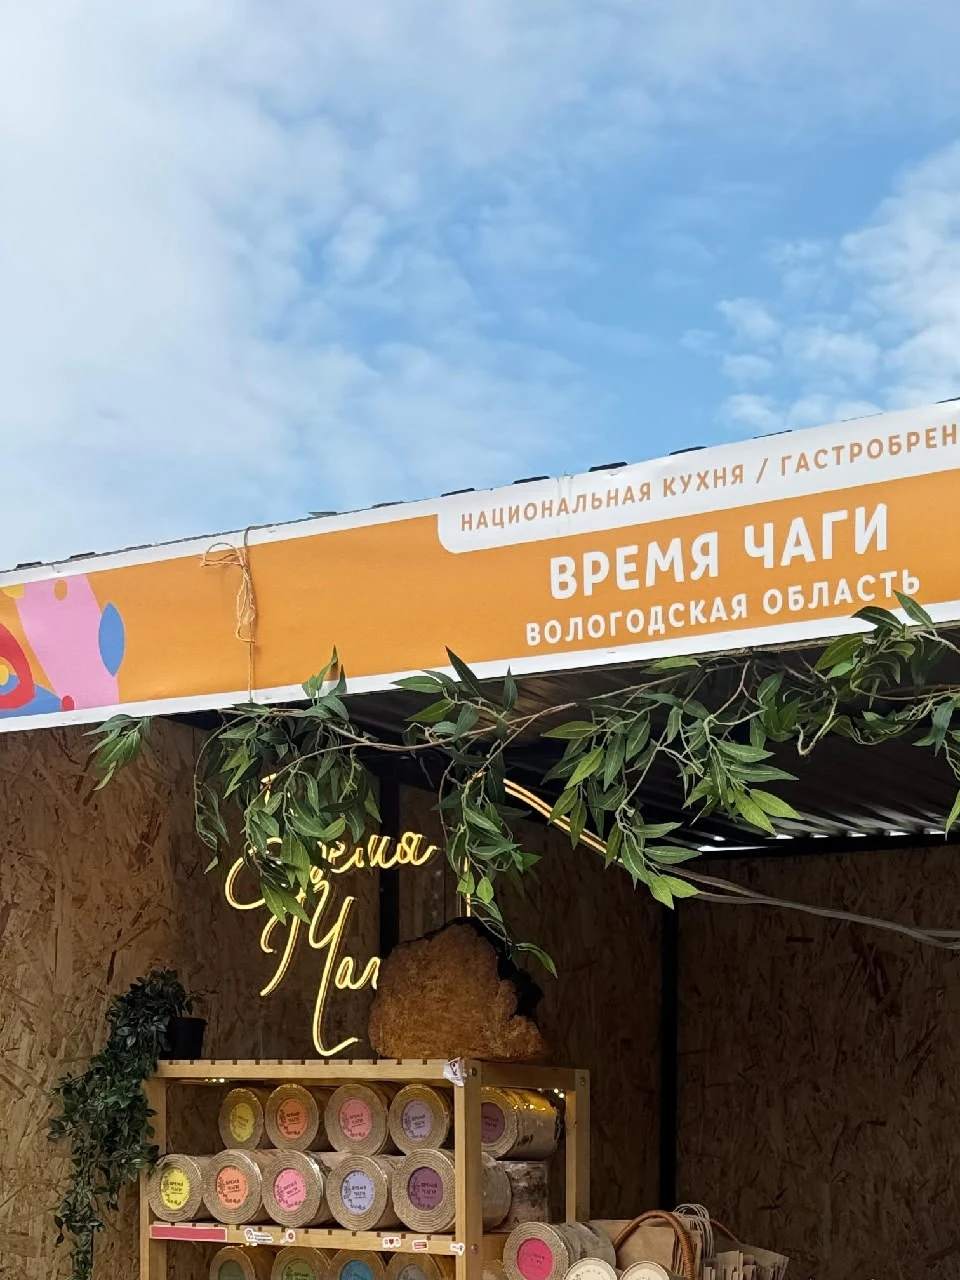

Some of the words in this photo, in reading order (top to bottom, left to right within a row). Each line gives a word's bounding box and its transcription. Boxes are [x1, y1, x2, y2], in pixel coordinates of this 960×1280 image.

[461, 481, 652, 533] НАЦИОНАЛЬНАЯ
[663, 465, 746, 498] КУХНЯ
[549, 531, 720, 600] ВРЕМЯ
[744, 503, 889, 570] ЧАГИ
[525, 591, 749, 647] ВОЛОГОДСКАЯ
[763, 569, 921, 615] ОБЛАСТЬ
